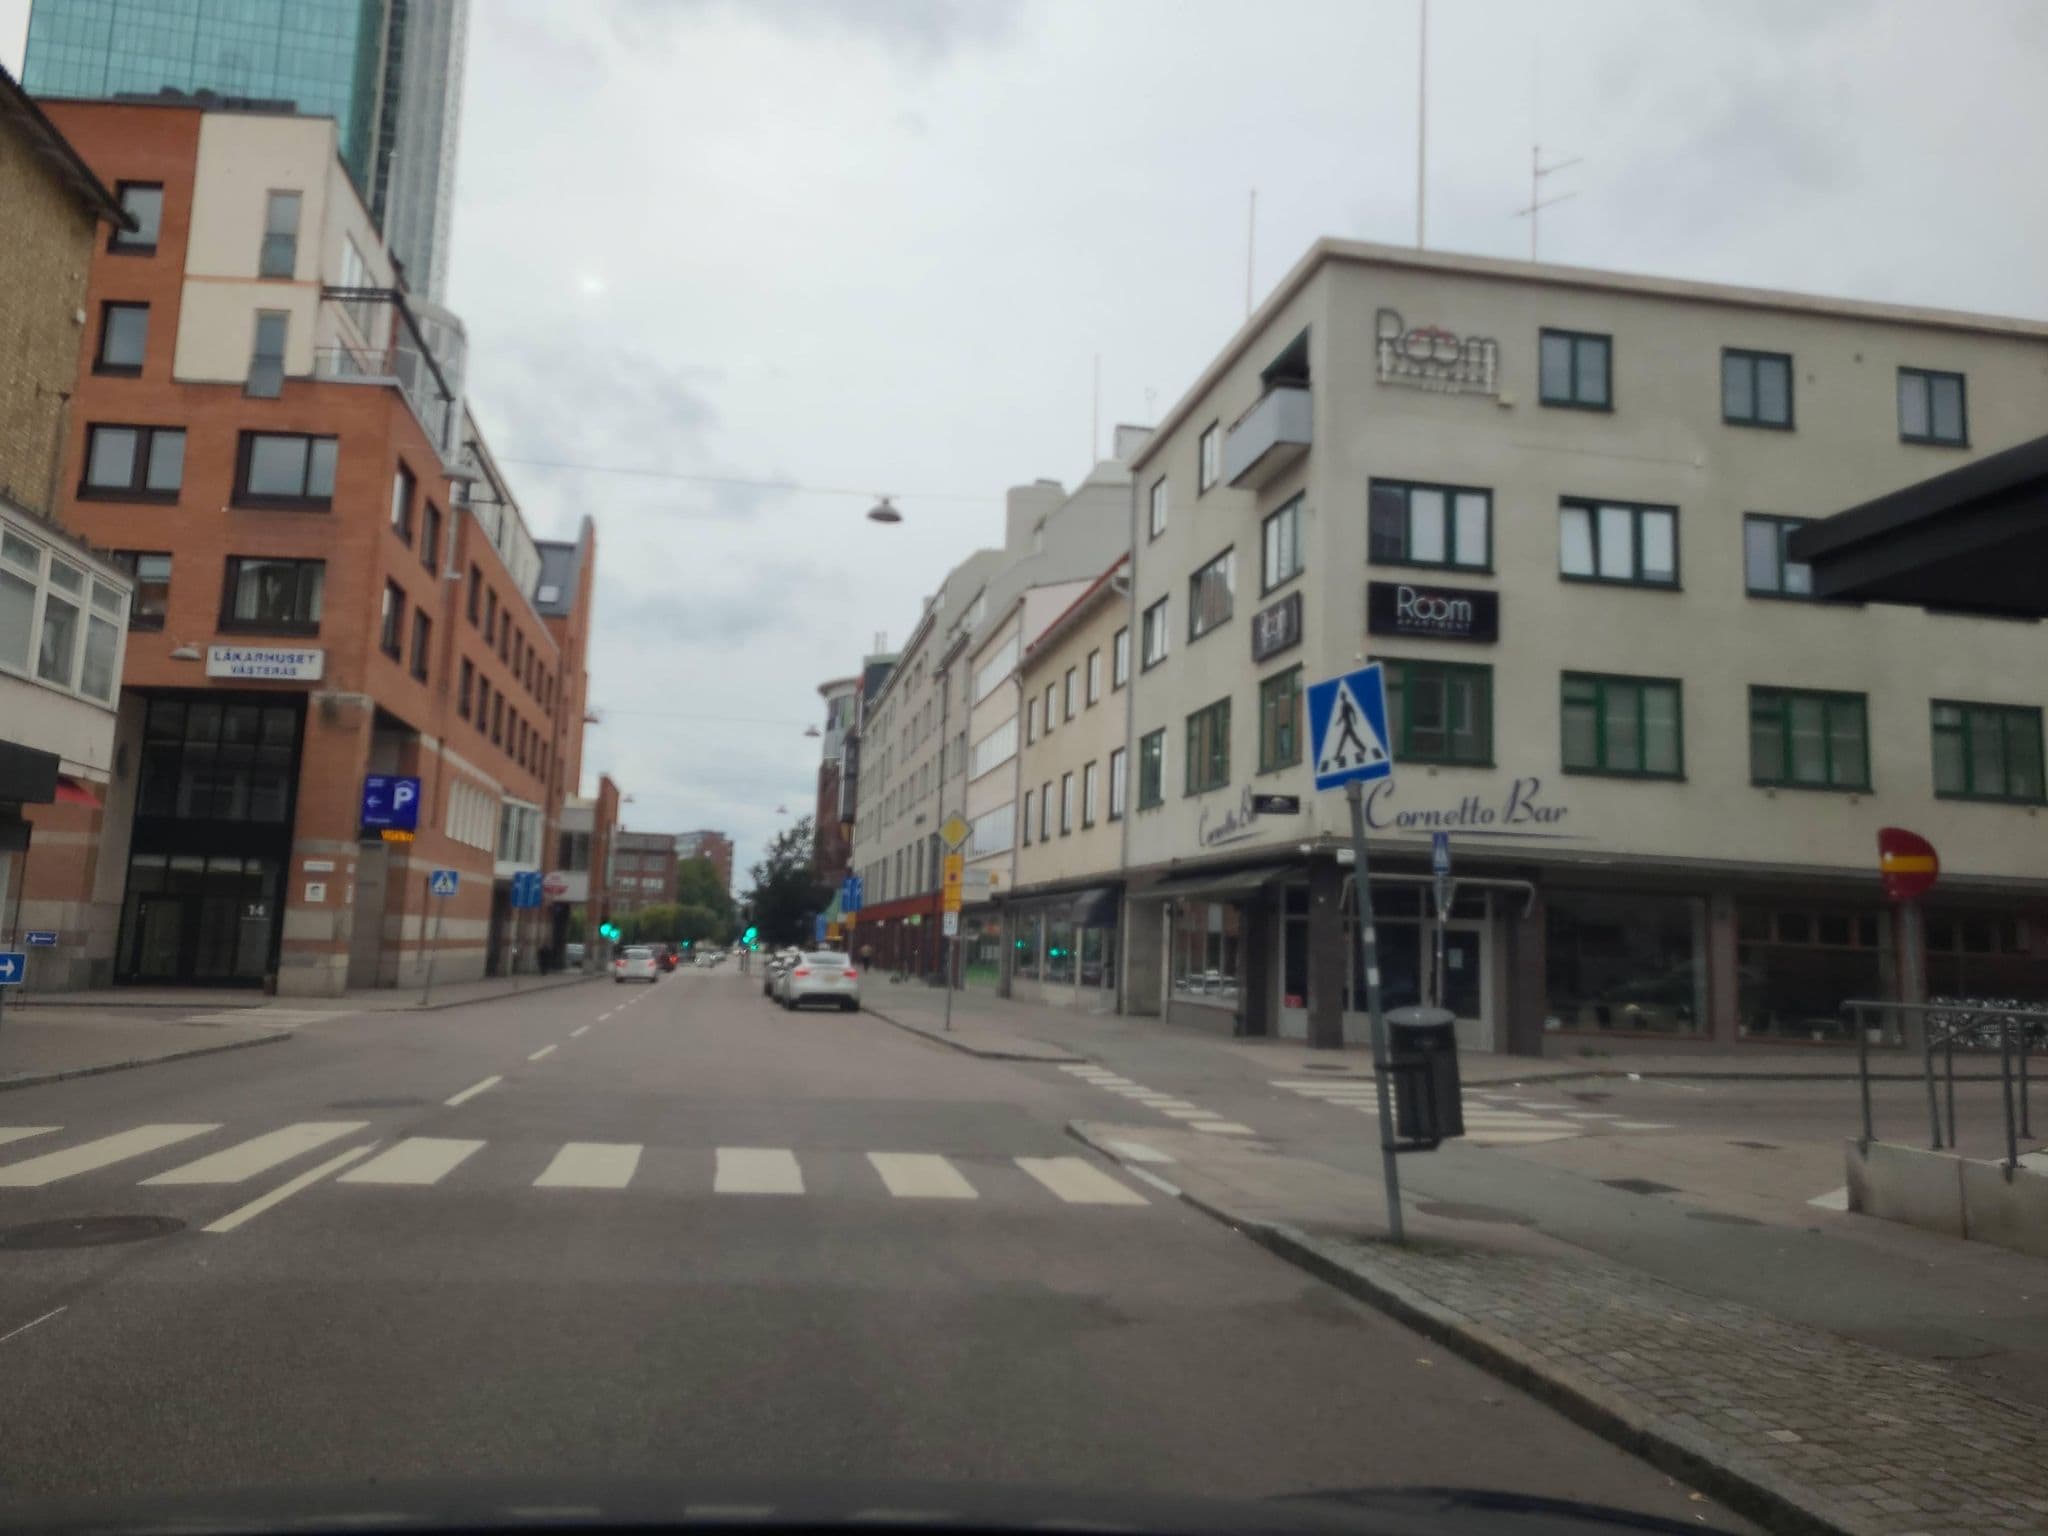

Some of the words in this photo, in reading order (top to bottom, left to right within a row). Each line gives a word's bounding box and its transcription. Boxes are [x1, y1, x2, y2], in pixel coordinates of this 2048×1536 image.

[1397, 586, 1472, 622] Room
[393, 787, 415, 811] P
[1366, 779, 1496, 829] Cornetto
[1504, 777, 1569, 824] Bar
[248, 903, 265, 916] 14
